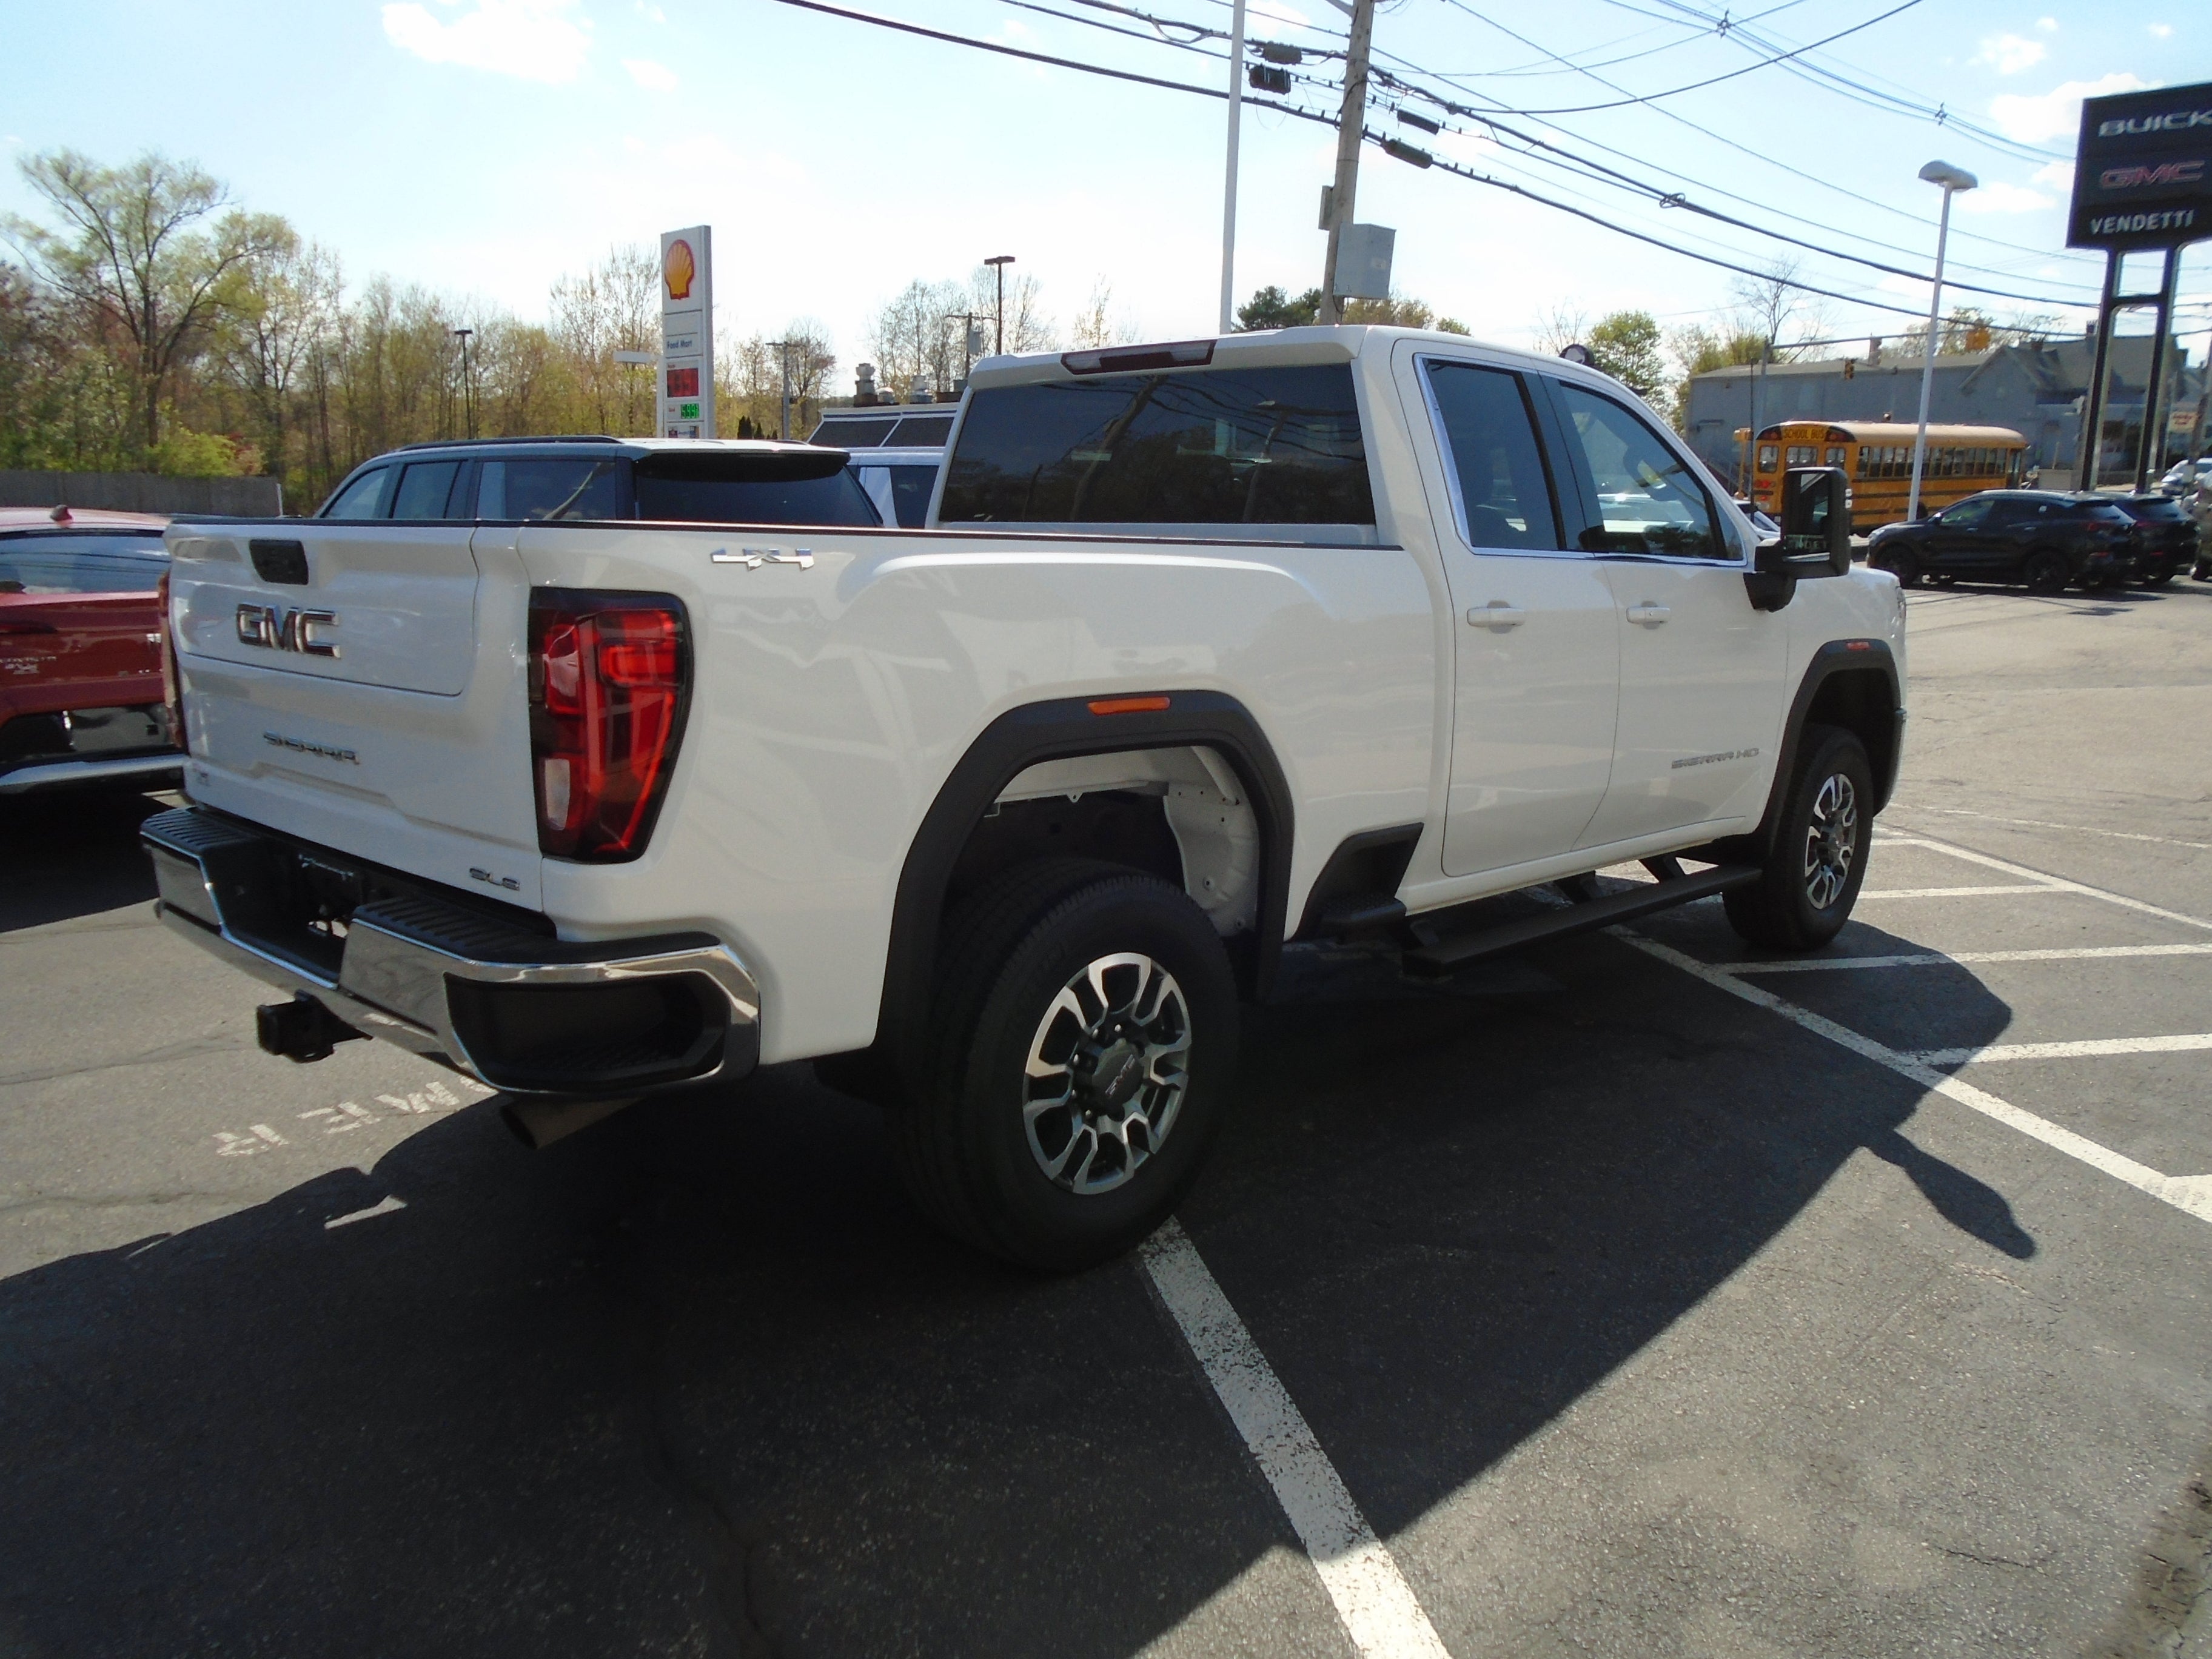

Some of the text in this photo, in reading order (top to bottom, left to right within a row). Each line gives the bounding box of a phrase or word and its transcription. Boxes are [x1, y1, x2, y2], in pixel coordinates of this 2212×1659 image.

[2099, 110, 2212, 137] BUICK
[2100, 160, 2205, 190] GMC
[2090, 210, 2194, 235] VENDETTI
[1785, 428, 1825, 438] SCHOOL BUS
[236, 603, 342, 659] GMC
[263, 730, 359, 765] SIERRA
[1671, 748, 1760, 769] SIERRA HD
